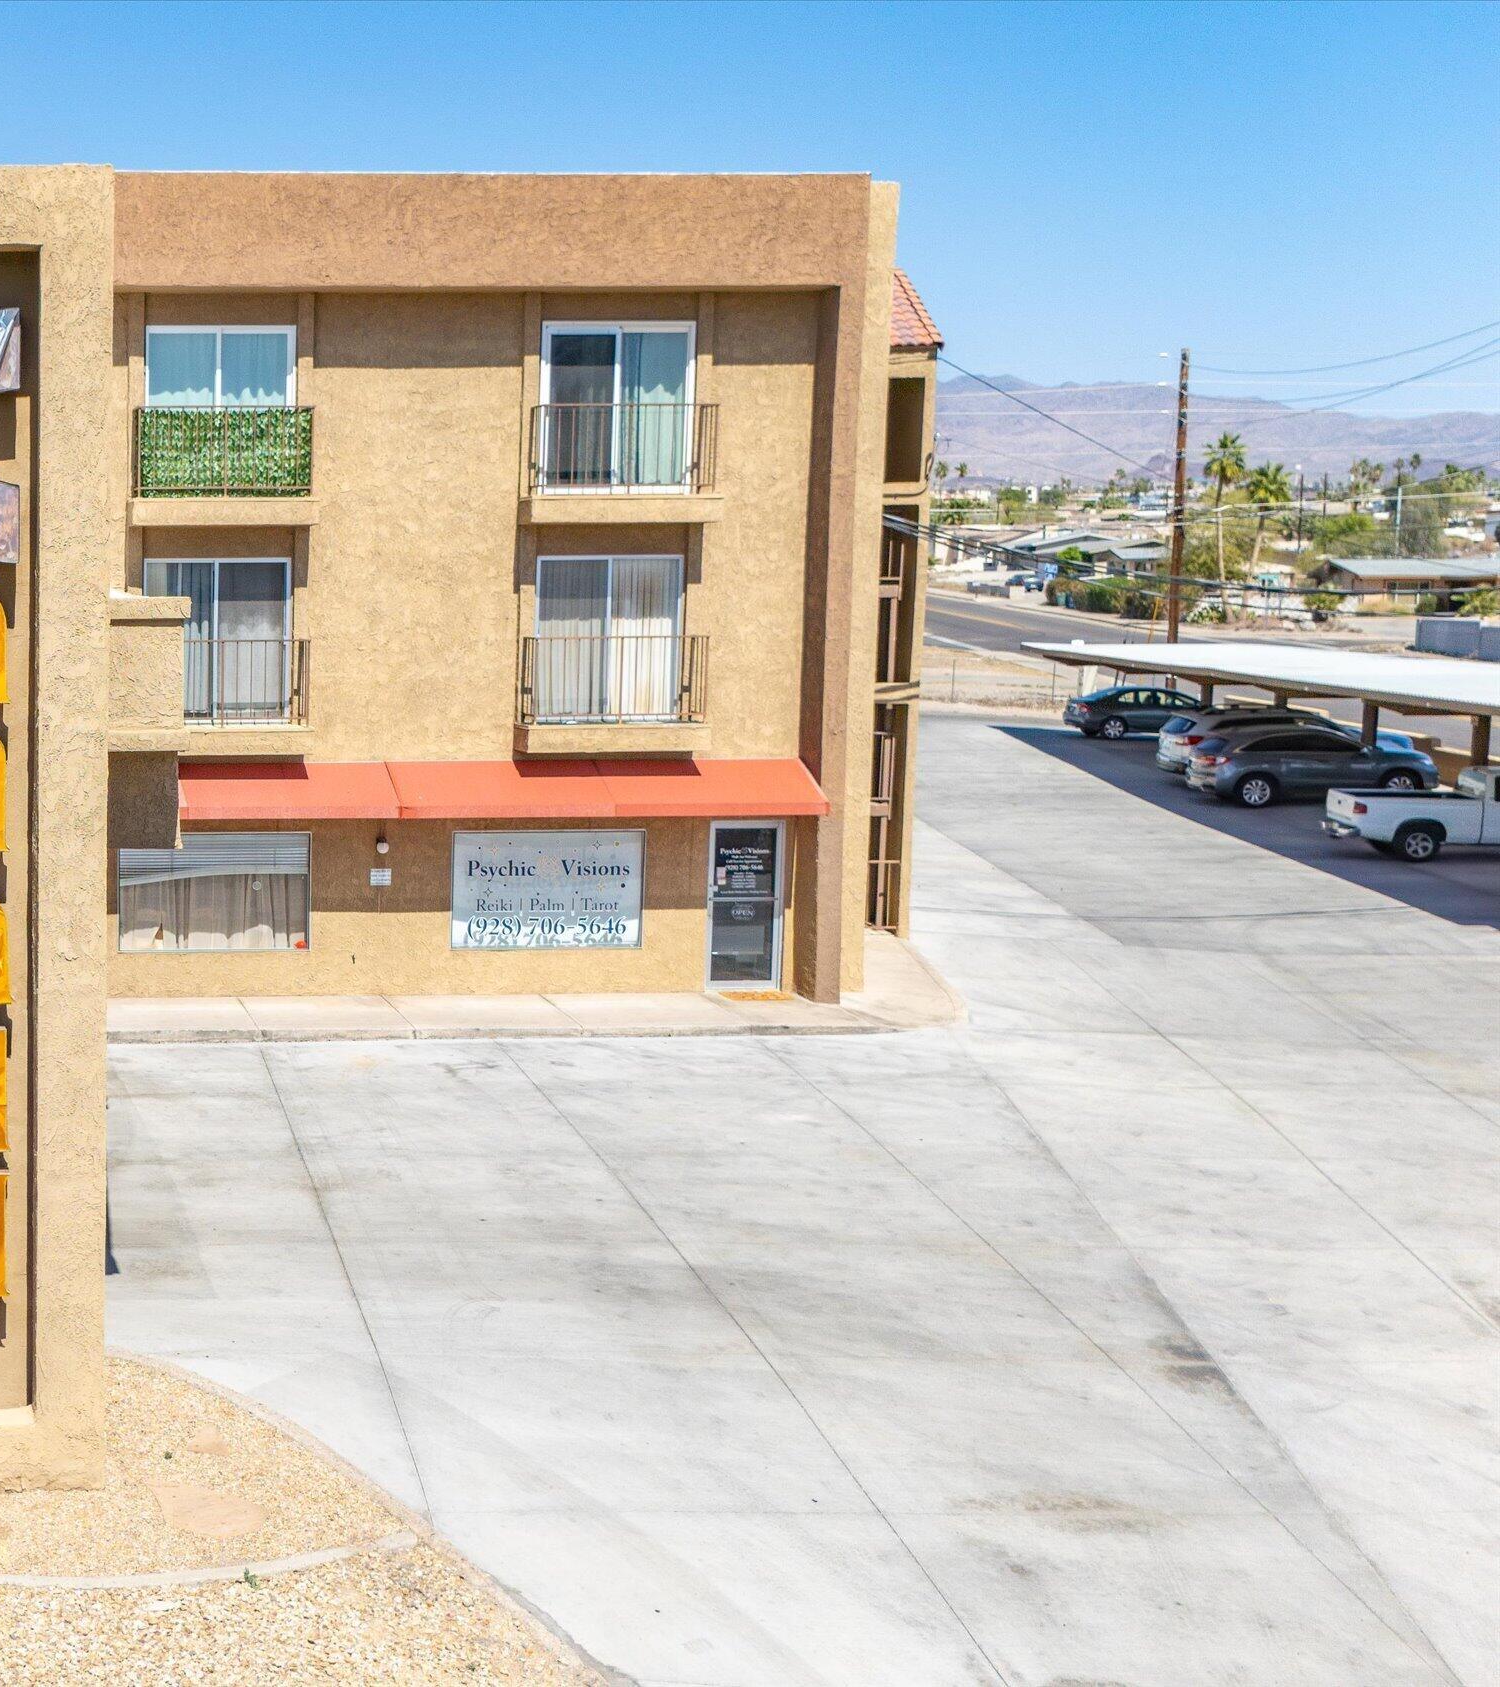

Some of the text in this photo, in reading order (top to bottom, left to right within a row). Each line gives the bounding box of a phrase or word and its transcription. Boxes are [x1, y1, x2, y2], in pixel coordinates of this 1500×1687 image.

[467, 859, 630, 882] Psychic Visions
[476, 898, 512, 912] Reiki
[529, 898, 565, 912] Palm
[580, 897, 619, 911] Tarot
[467, 916, 627, 940] (928) 706-5646
